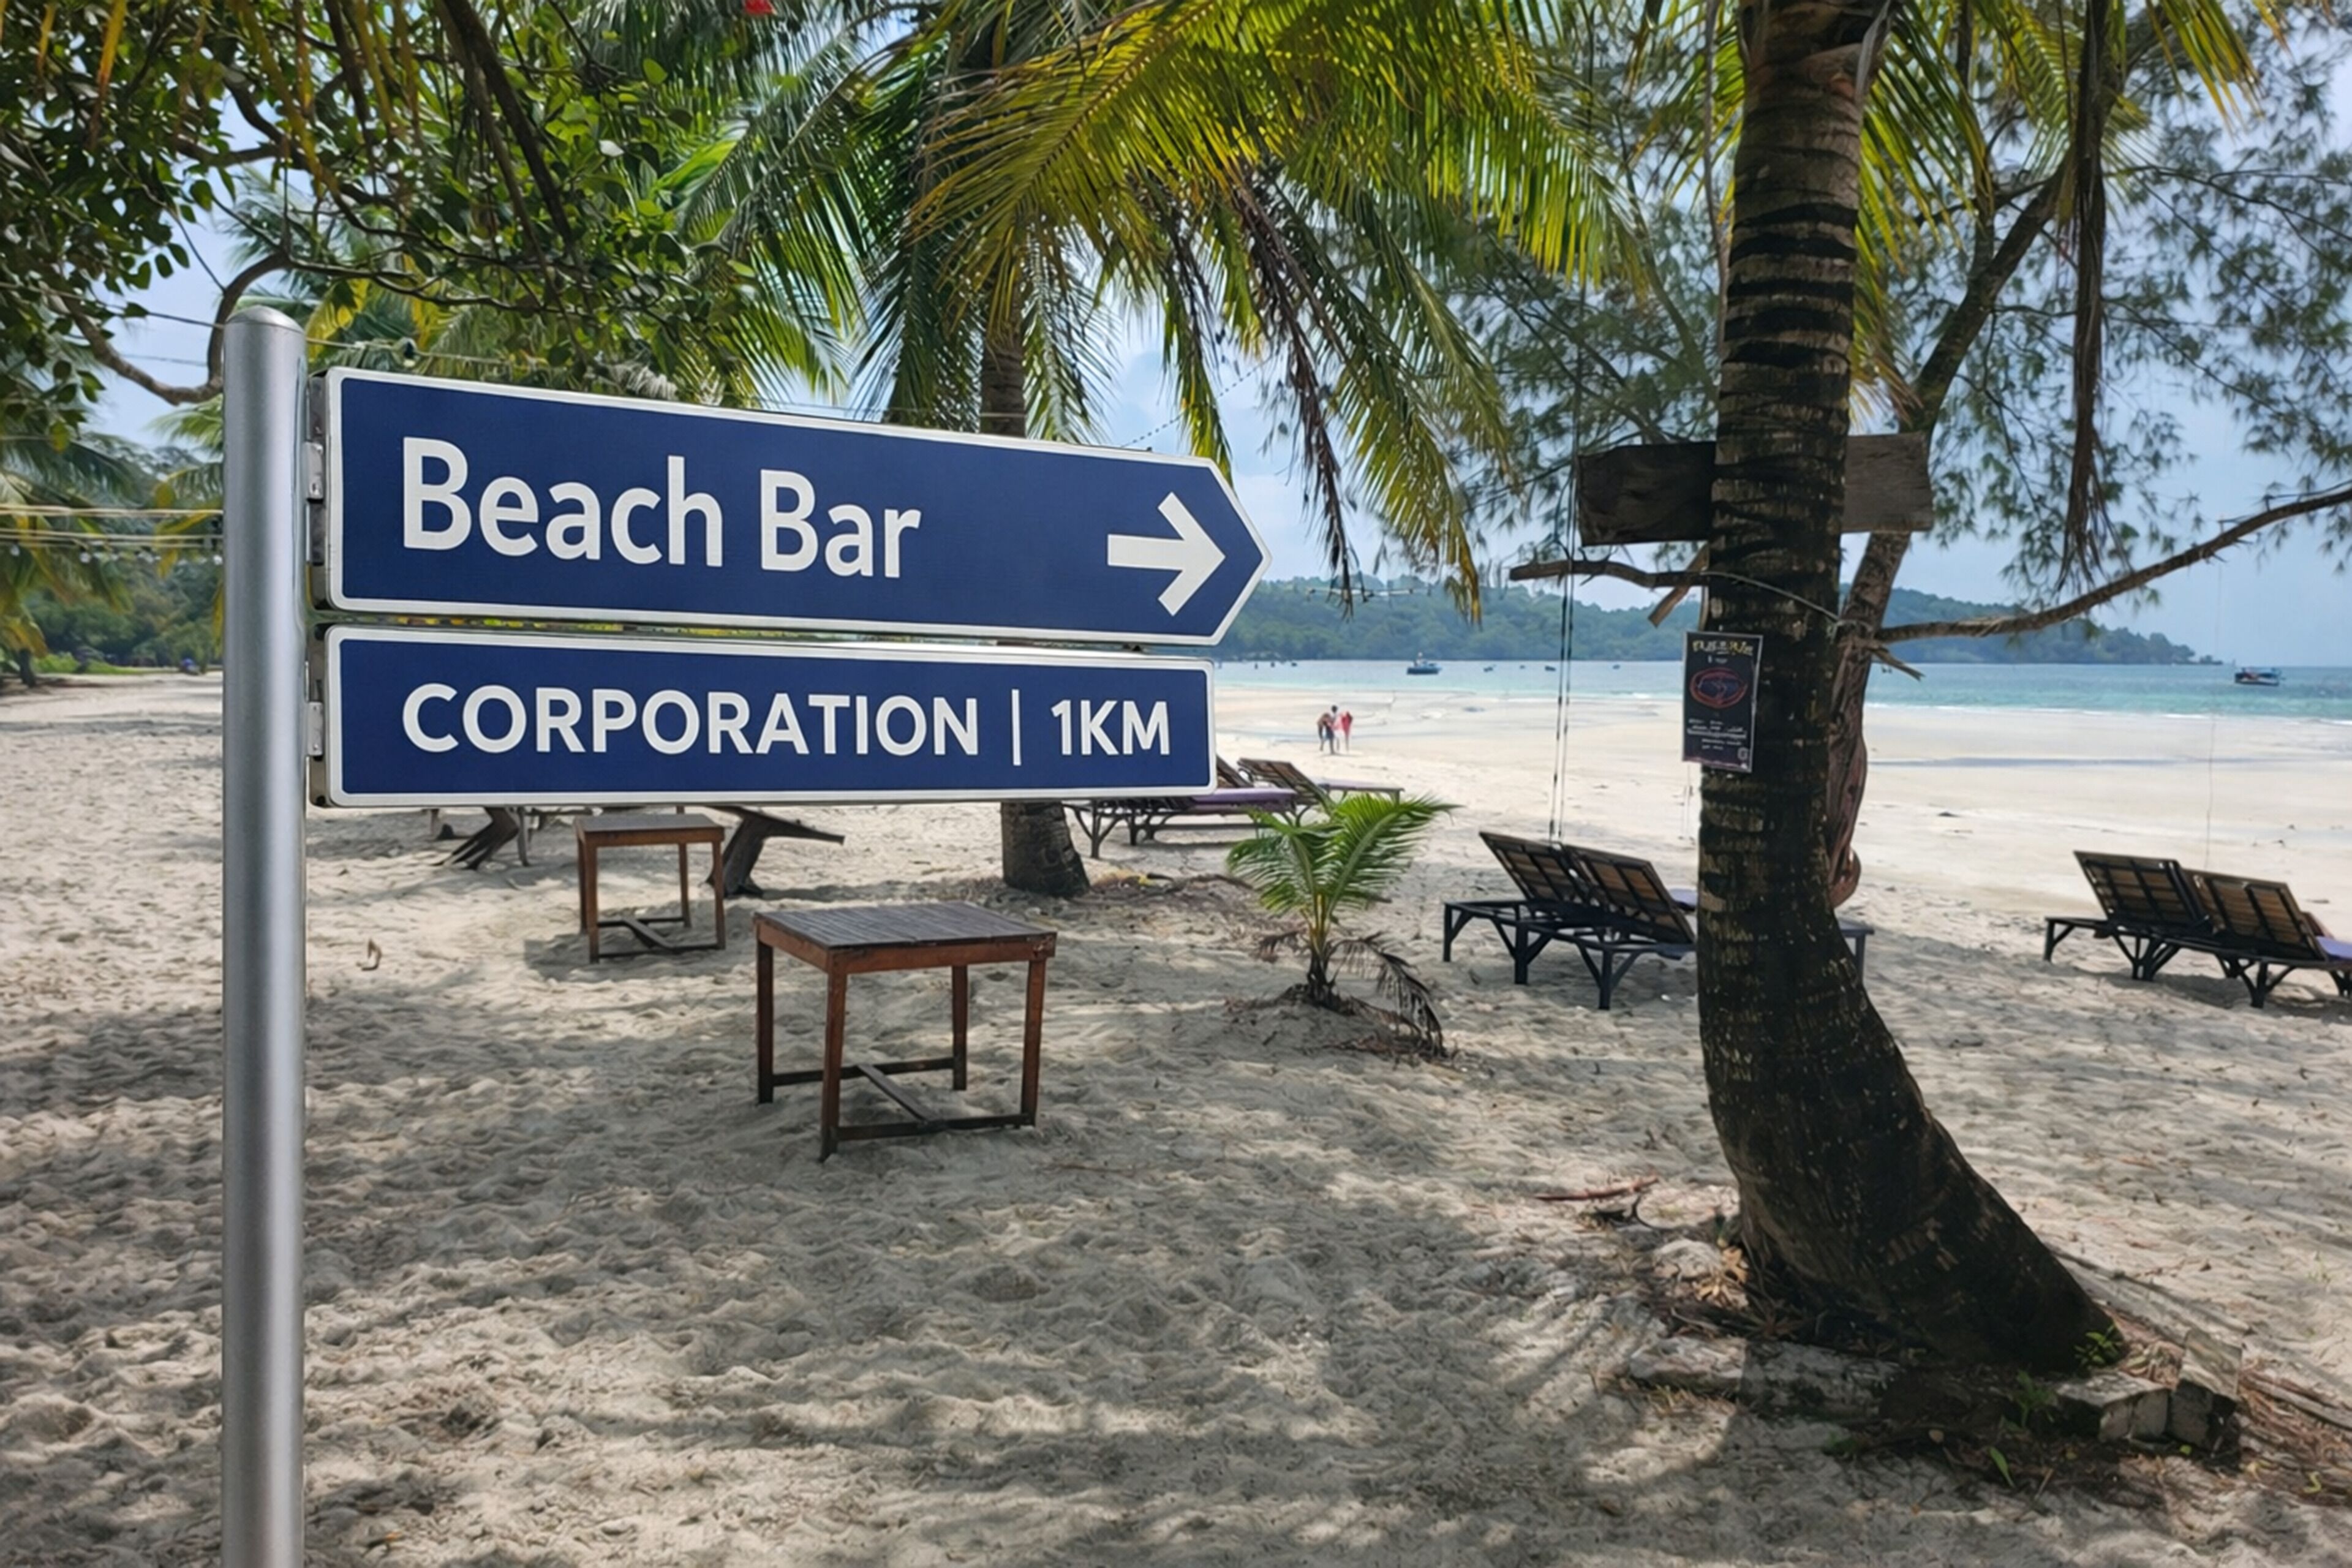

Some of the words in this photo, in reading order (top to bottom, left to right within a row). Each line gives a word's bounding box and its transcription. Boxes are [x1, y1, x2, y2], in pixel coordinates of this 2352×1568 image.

[403, 437, 723, 567] Beach
[760, 469, 921, 578] Bar
[402, 683, 978, 756] CORPORATION
[1051, 699, 1170, 755] 1KM
